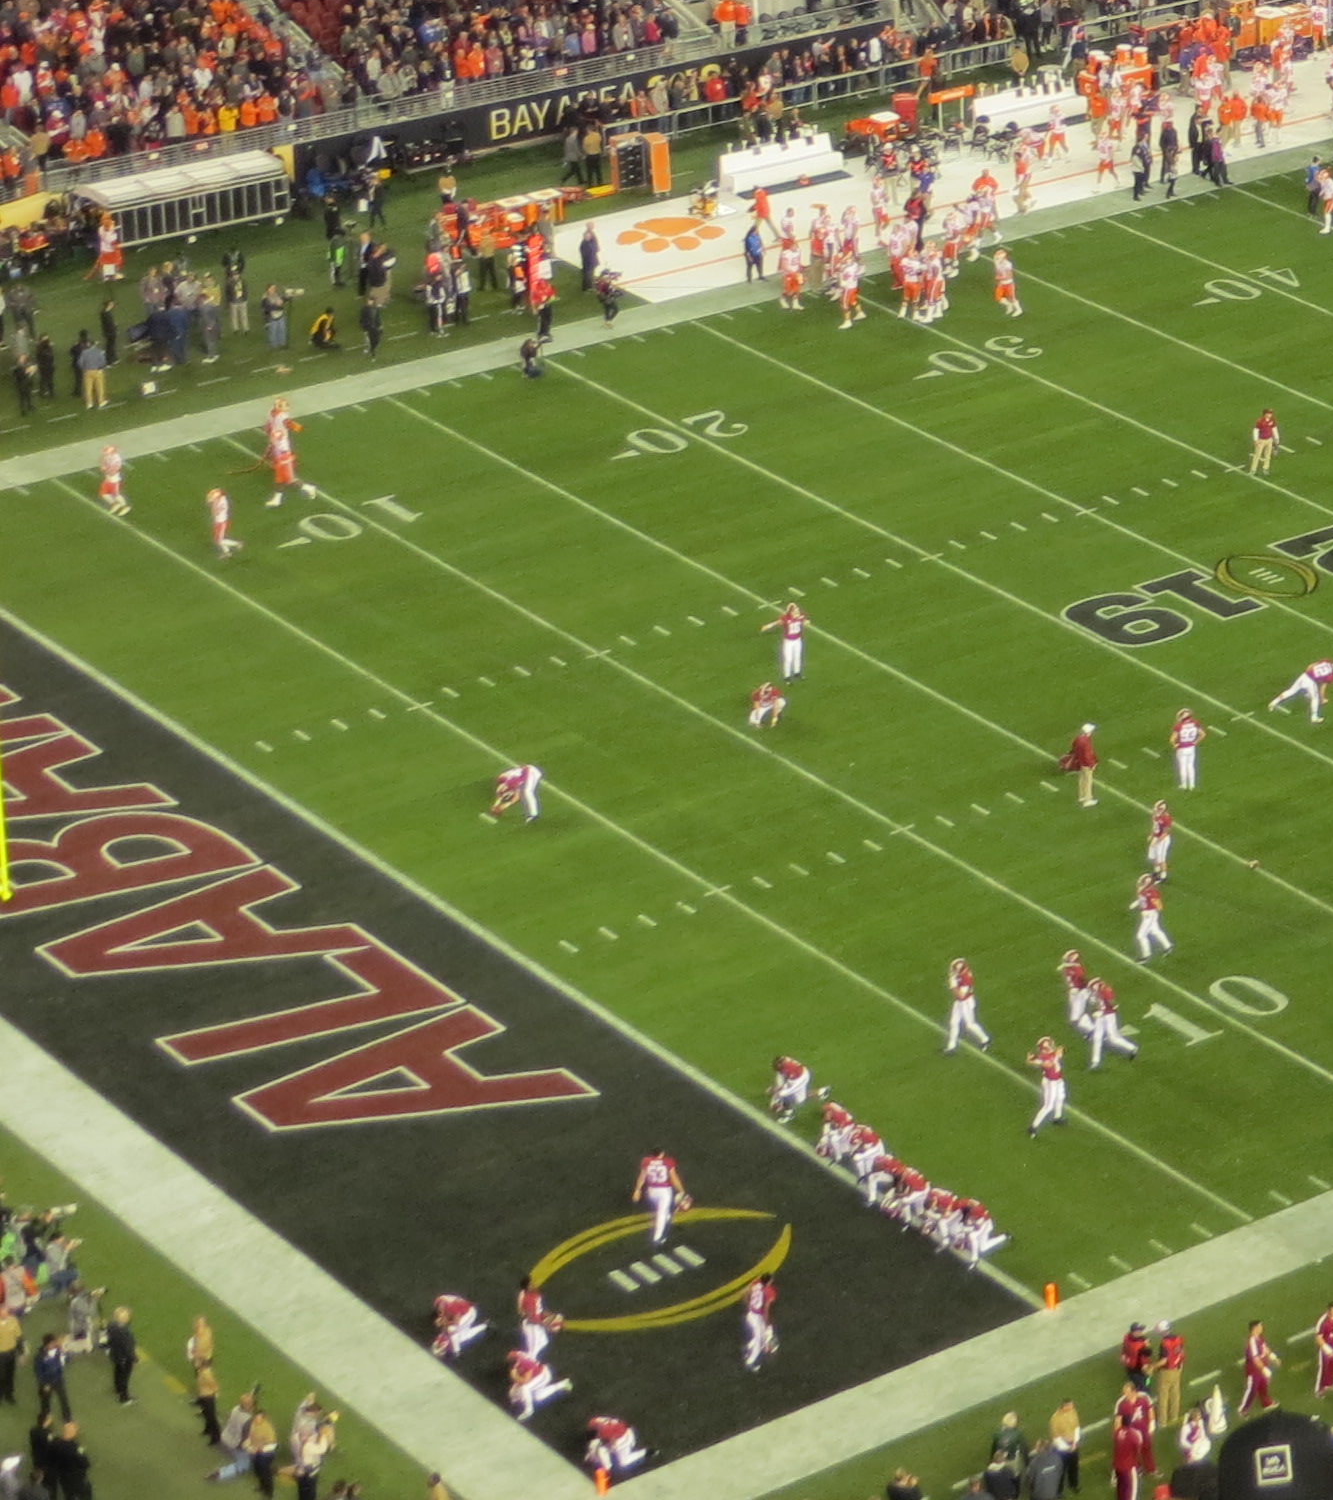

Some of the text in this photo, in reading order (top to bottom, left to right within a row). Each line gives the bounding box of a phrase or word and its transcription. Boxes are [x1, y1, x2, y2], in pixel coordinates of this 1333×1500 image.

[489, 98, 551, 141] BAY
[1203, 264, 1302, 303] 40
[927, 334, 1045, 378] 30
[626, 408, 749, 457] 20
[314, 493, 425, 542] 10
[1142, 973, 1290, 1047] 10
